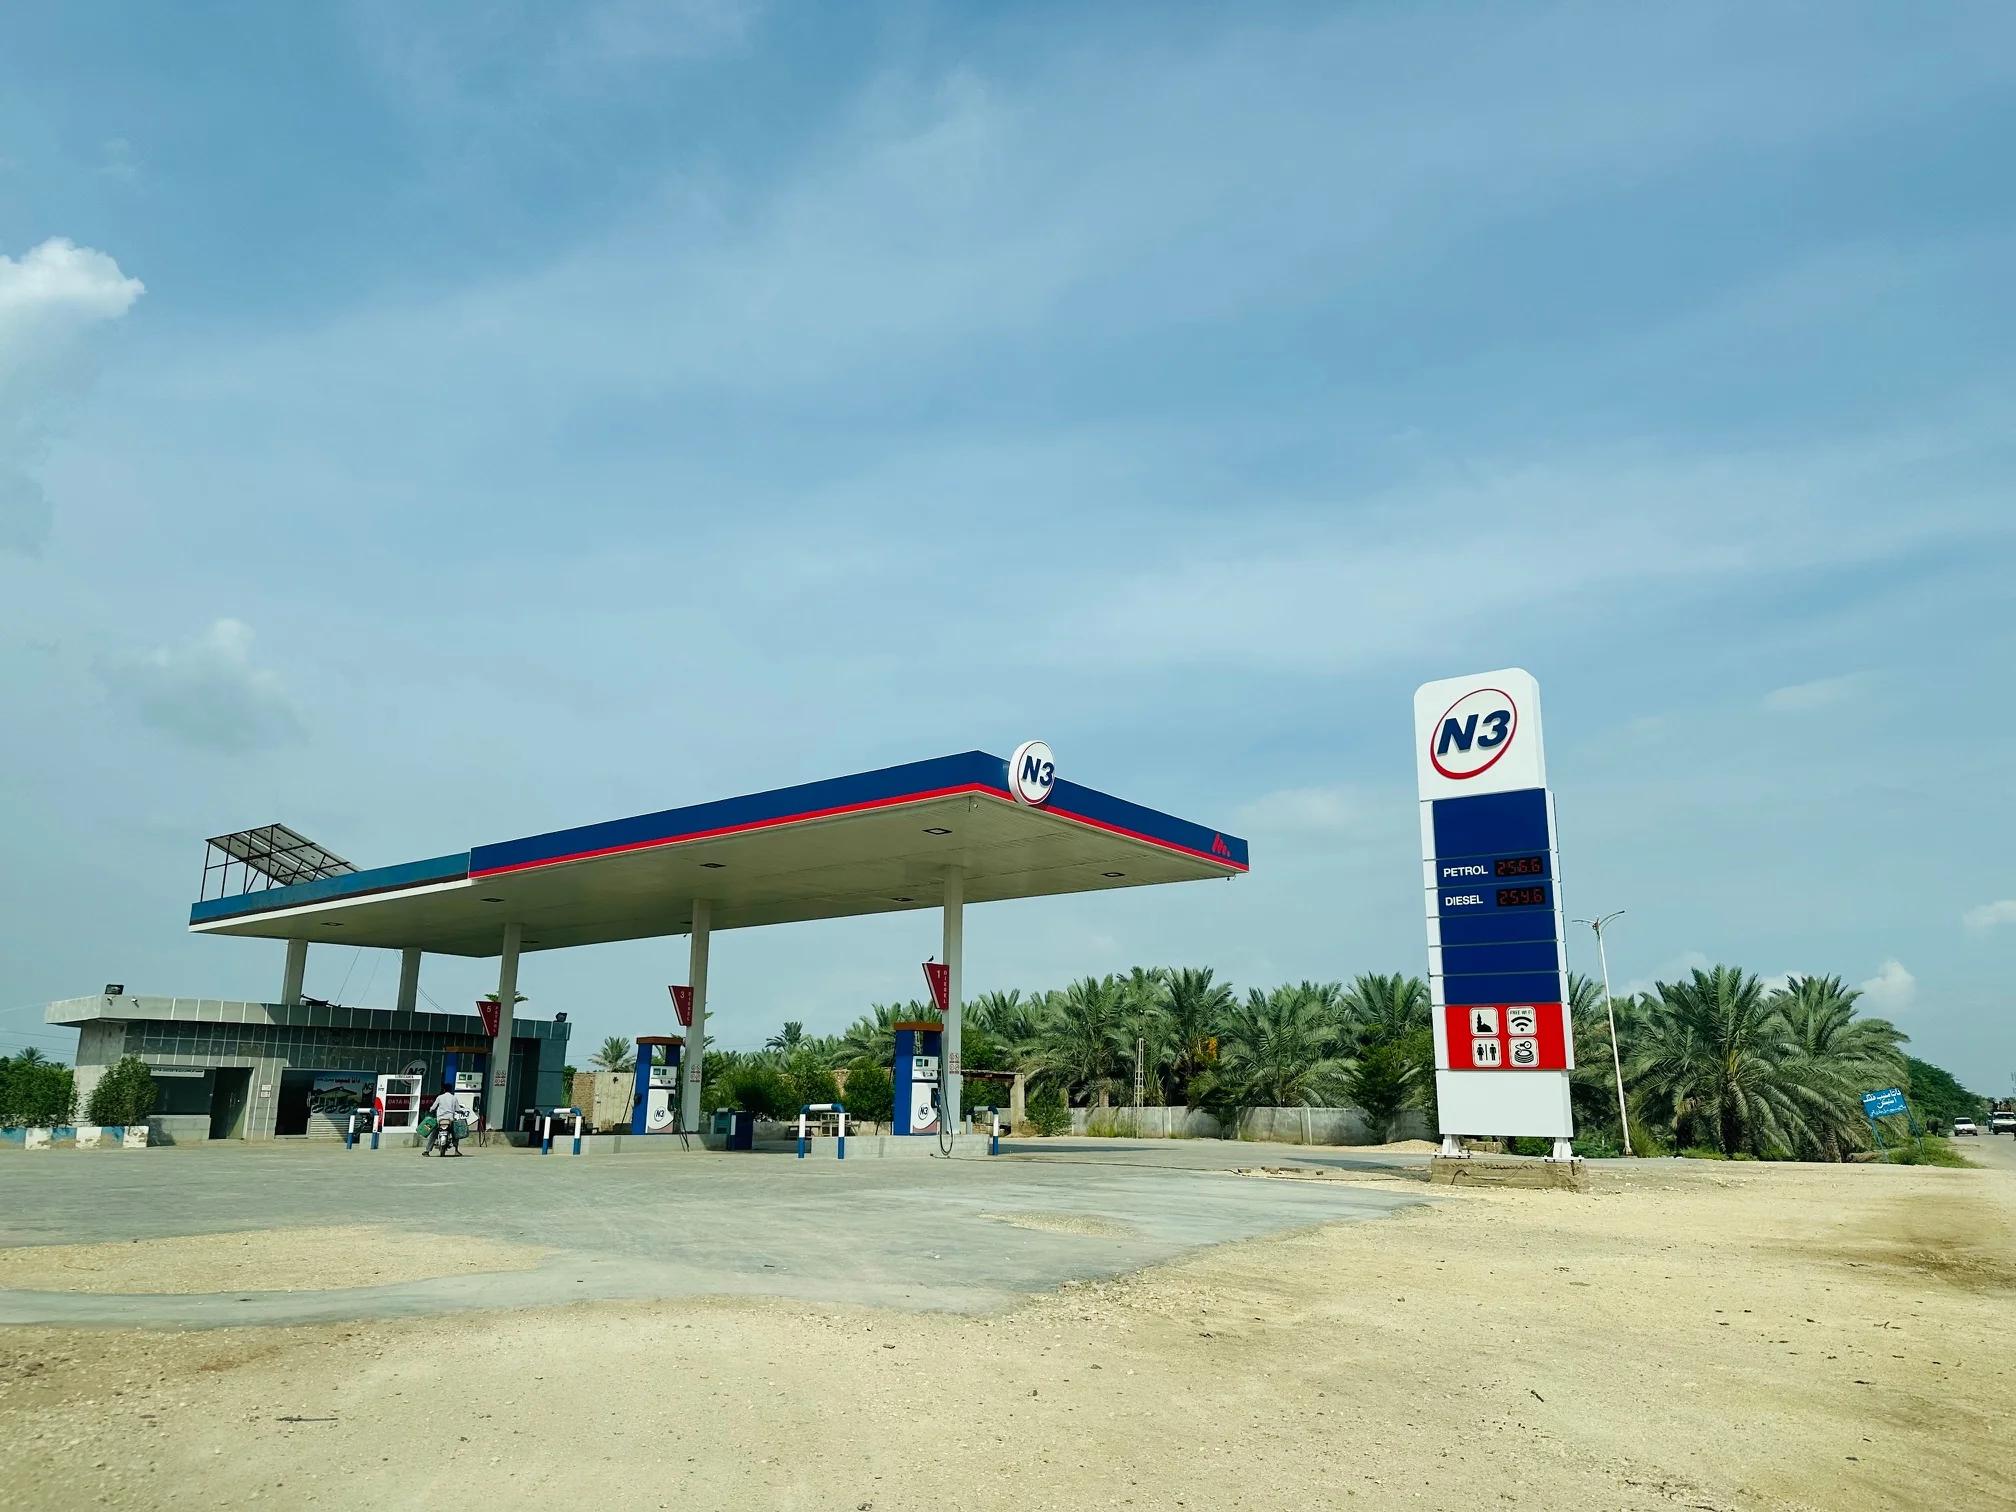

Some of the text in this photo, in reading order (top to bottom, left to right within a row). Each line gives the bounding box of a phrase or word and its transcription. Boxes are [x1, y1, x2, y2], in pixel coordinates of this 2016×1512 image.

[1437, 709, 1511, 756] N3
[1021, 754, 1055, 787] N3
[1443, 865, 1488, 878] PETROL
[1445, 894, 1484, 907] DIESEL
[936, 970, 941, 979] 1
[680, 991, 685, 999] 3
[486, 1005, 492, 1013] 5
[407, 1067, 425, 1076] N3
[460, 1110, 470, 1118] N3
[655, 1109, 665, 1118] N3
[919, 1106, 928, 1116] N3
